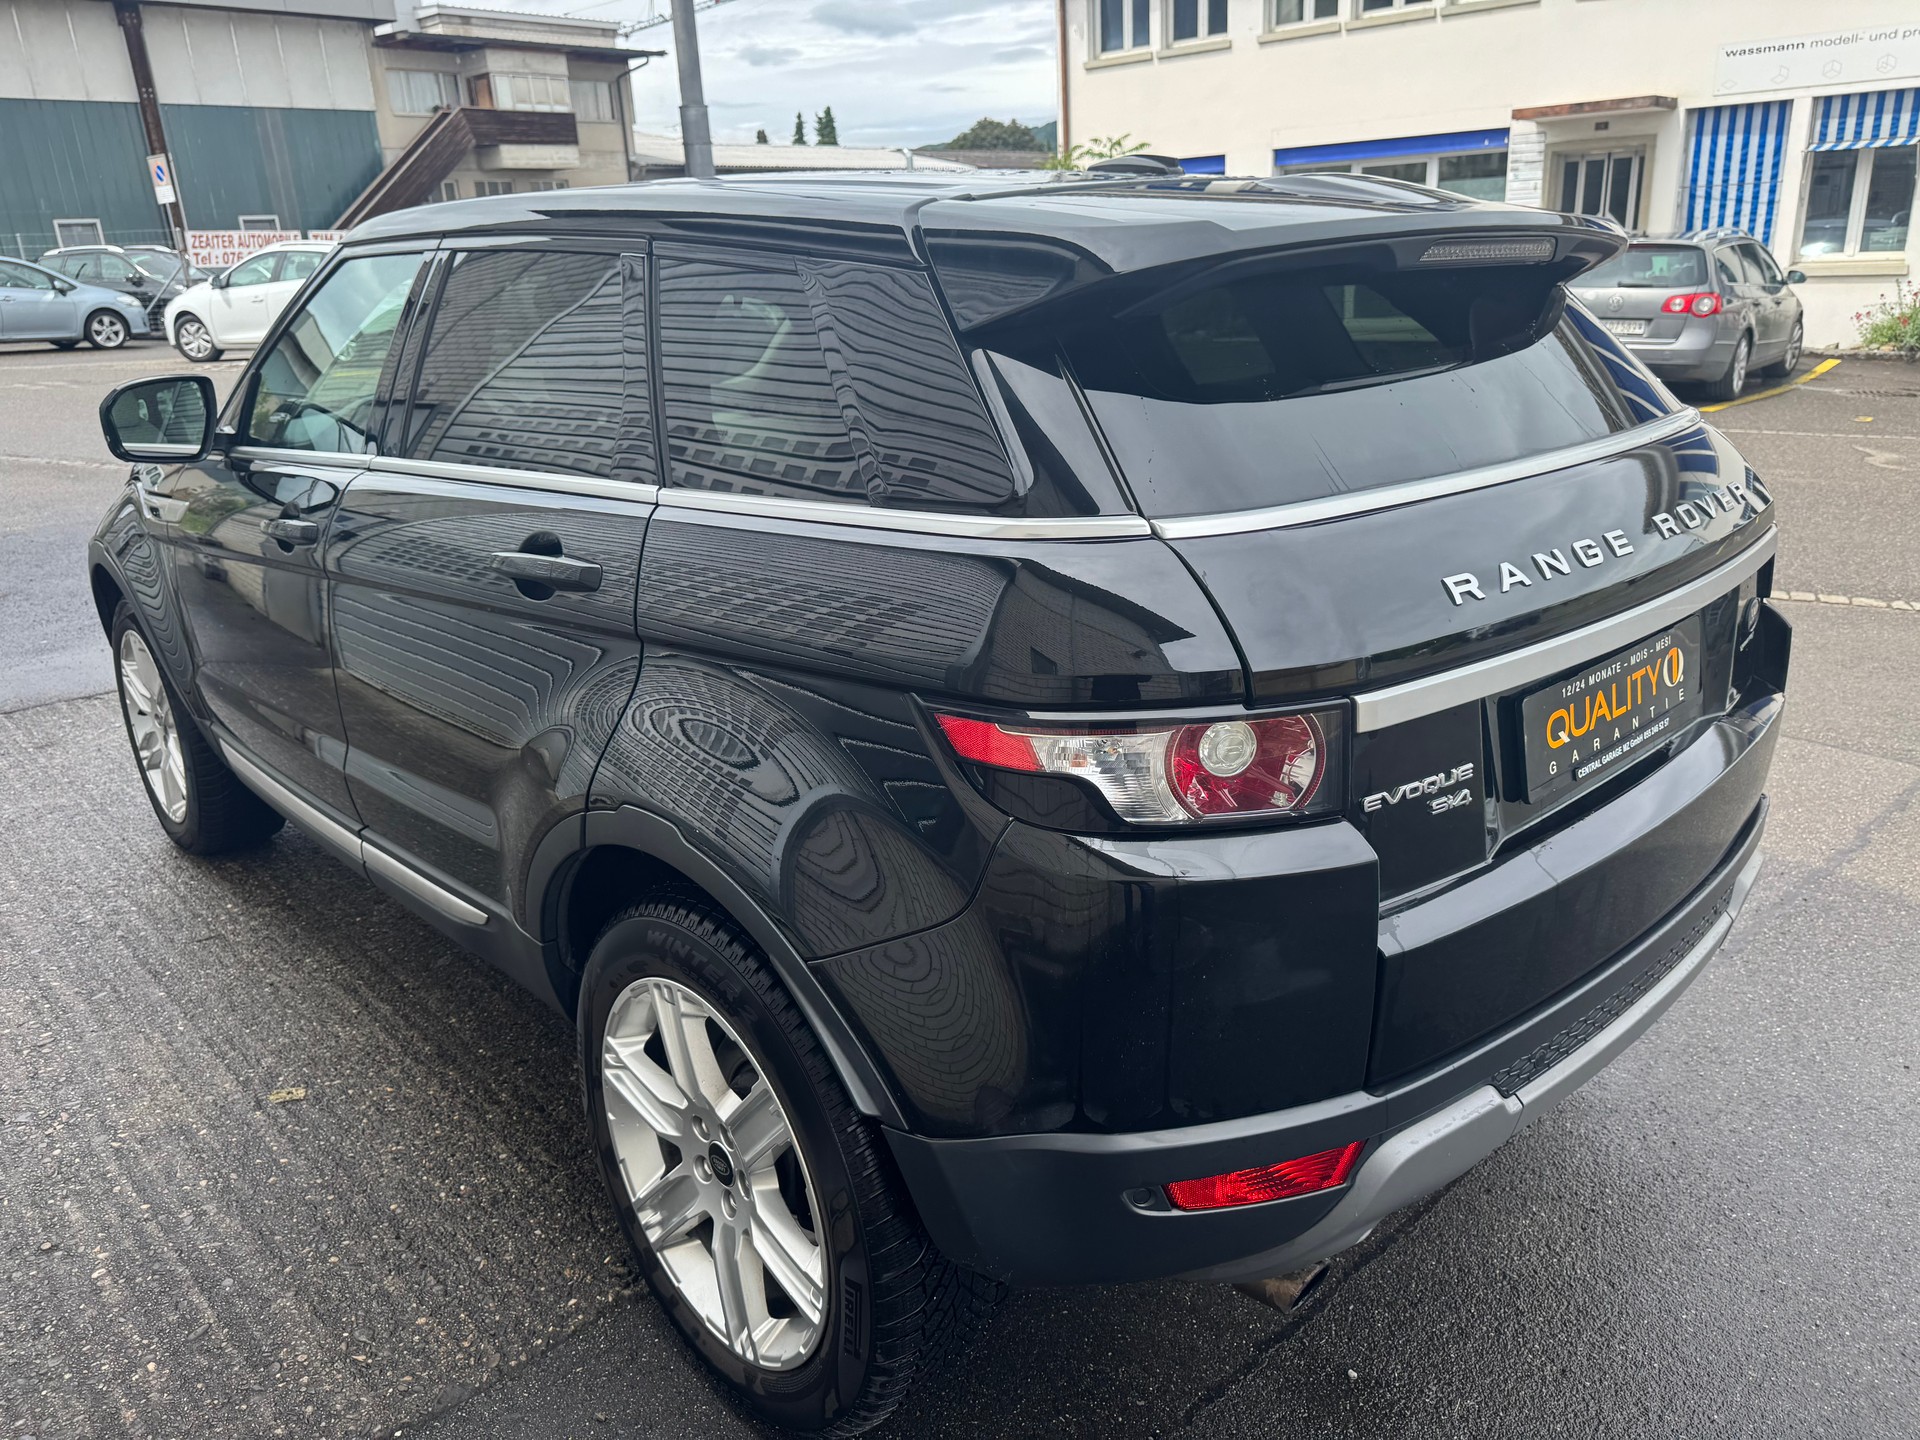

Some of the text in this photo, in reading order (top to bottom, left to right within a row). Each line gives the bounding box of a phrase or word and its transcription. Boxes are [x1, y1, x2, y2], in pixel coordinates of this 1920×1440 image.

[1725, 42, 1805, 58] wassmann
[1810, 33, 1864, 50] modell-
[1869, 28, 1899, 42] und
[193, 252, 212, 265] Tel
[1441, 481, 1748, 606] RANGE ROVER
[1562, 678, 1585, 698] 12/24
[1588, 661, 1621, 686] MONATE
[1630, 648, 1648, 666] MOIS
[1655, 635, 1671, 652] MESI
[1546, 658, 1662, 749] QUALITY
[1549, 688, 1685, 775] GARANTIE
[1361, 762, 1474, 813] EVOQUE
[1577, 757, 1603, 779] CENTRAL
[1601, 746, 1623, 765] GARAGE
[1630, 733, 1644, 748] GmbH
[646, 929, 743, 1001] WINTER
[844, 1276, 862, 1361] PIRELLI
